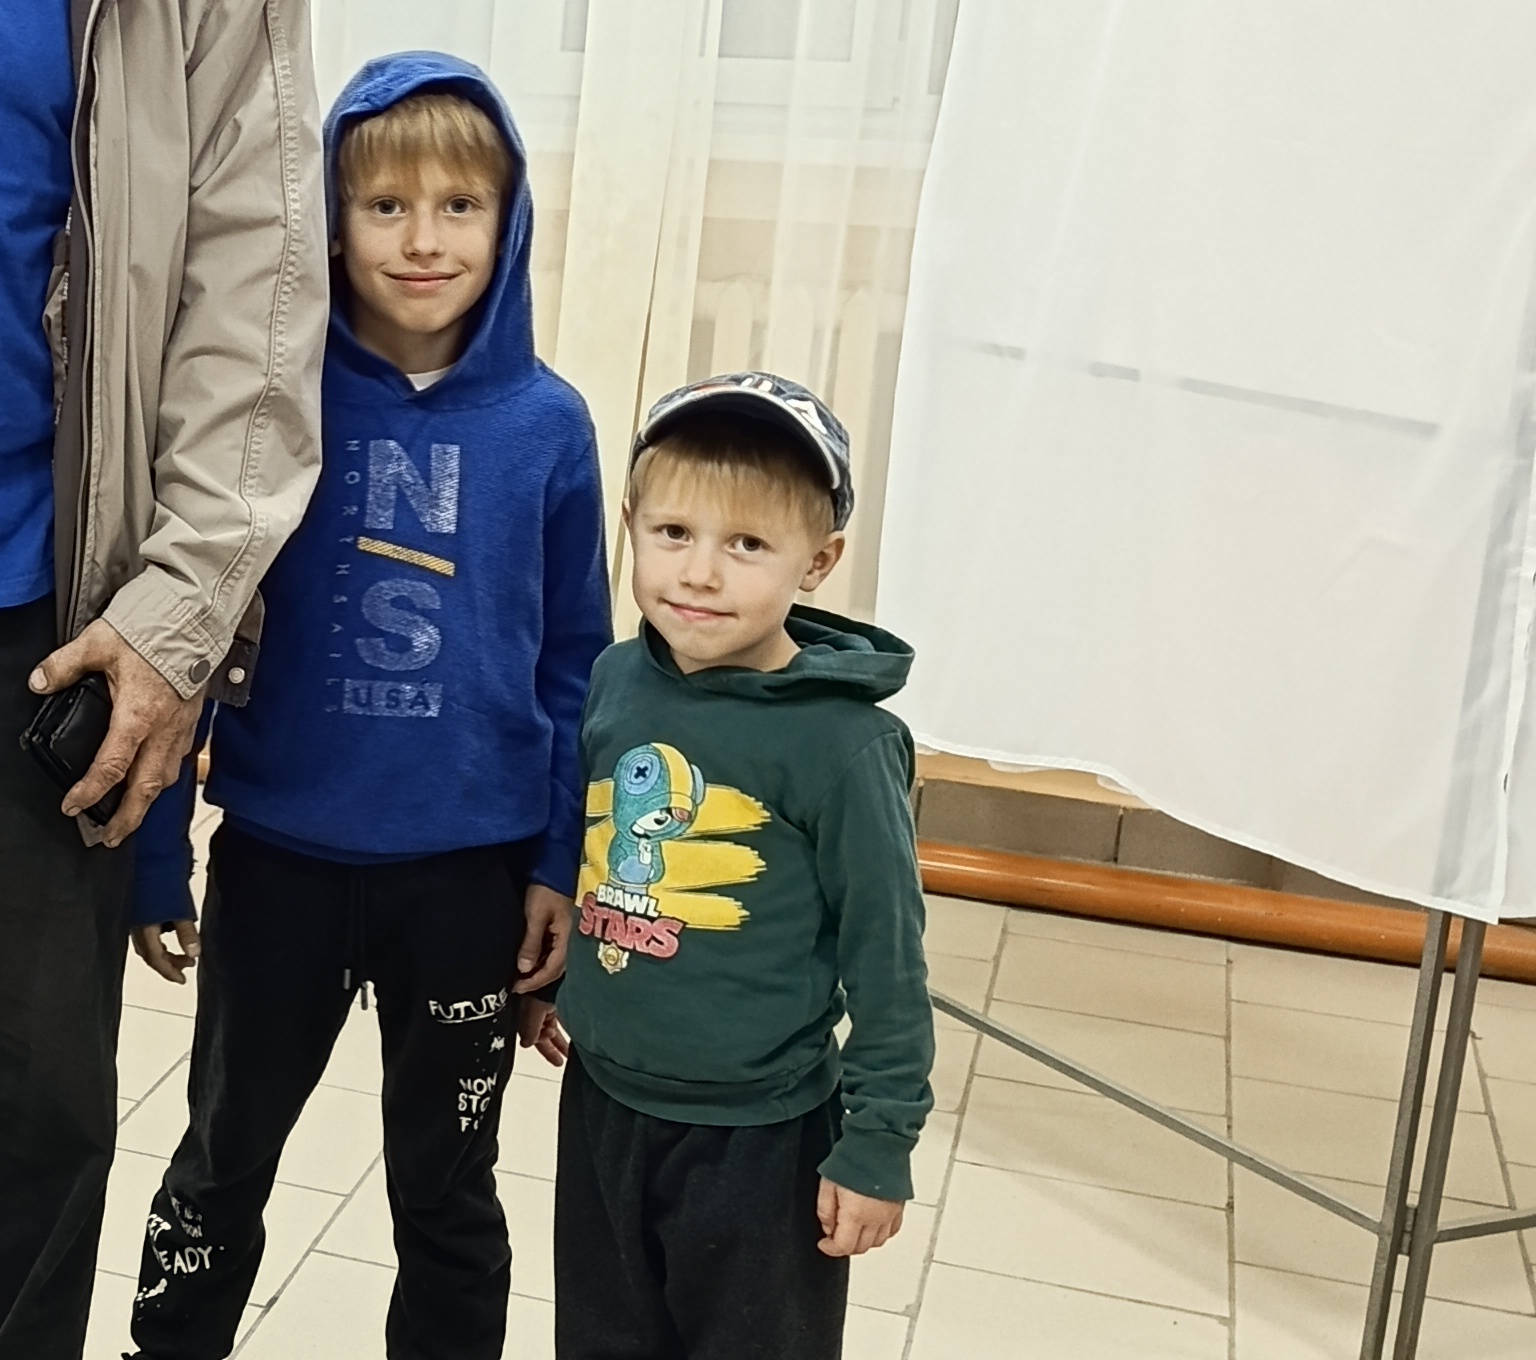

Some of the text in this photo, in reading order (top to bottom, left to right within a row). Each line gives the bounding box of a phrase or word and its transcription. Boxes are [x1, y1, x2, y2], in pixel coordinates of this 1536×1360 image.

[348, 683, 434, 712] USA
[596, 884, 660, 917] BRAWL
[579, 893, 685, 958] STARS
[428, 988, 508, 1019] FUTURE
[153, 1245, 213, 1275] EADY
